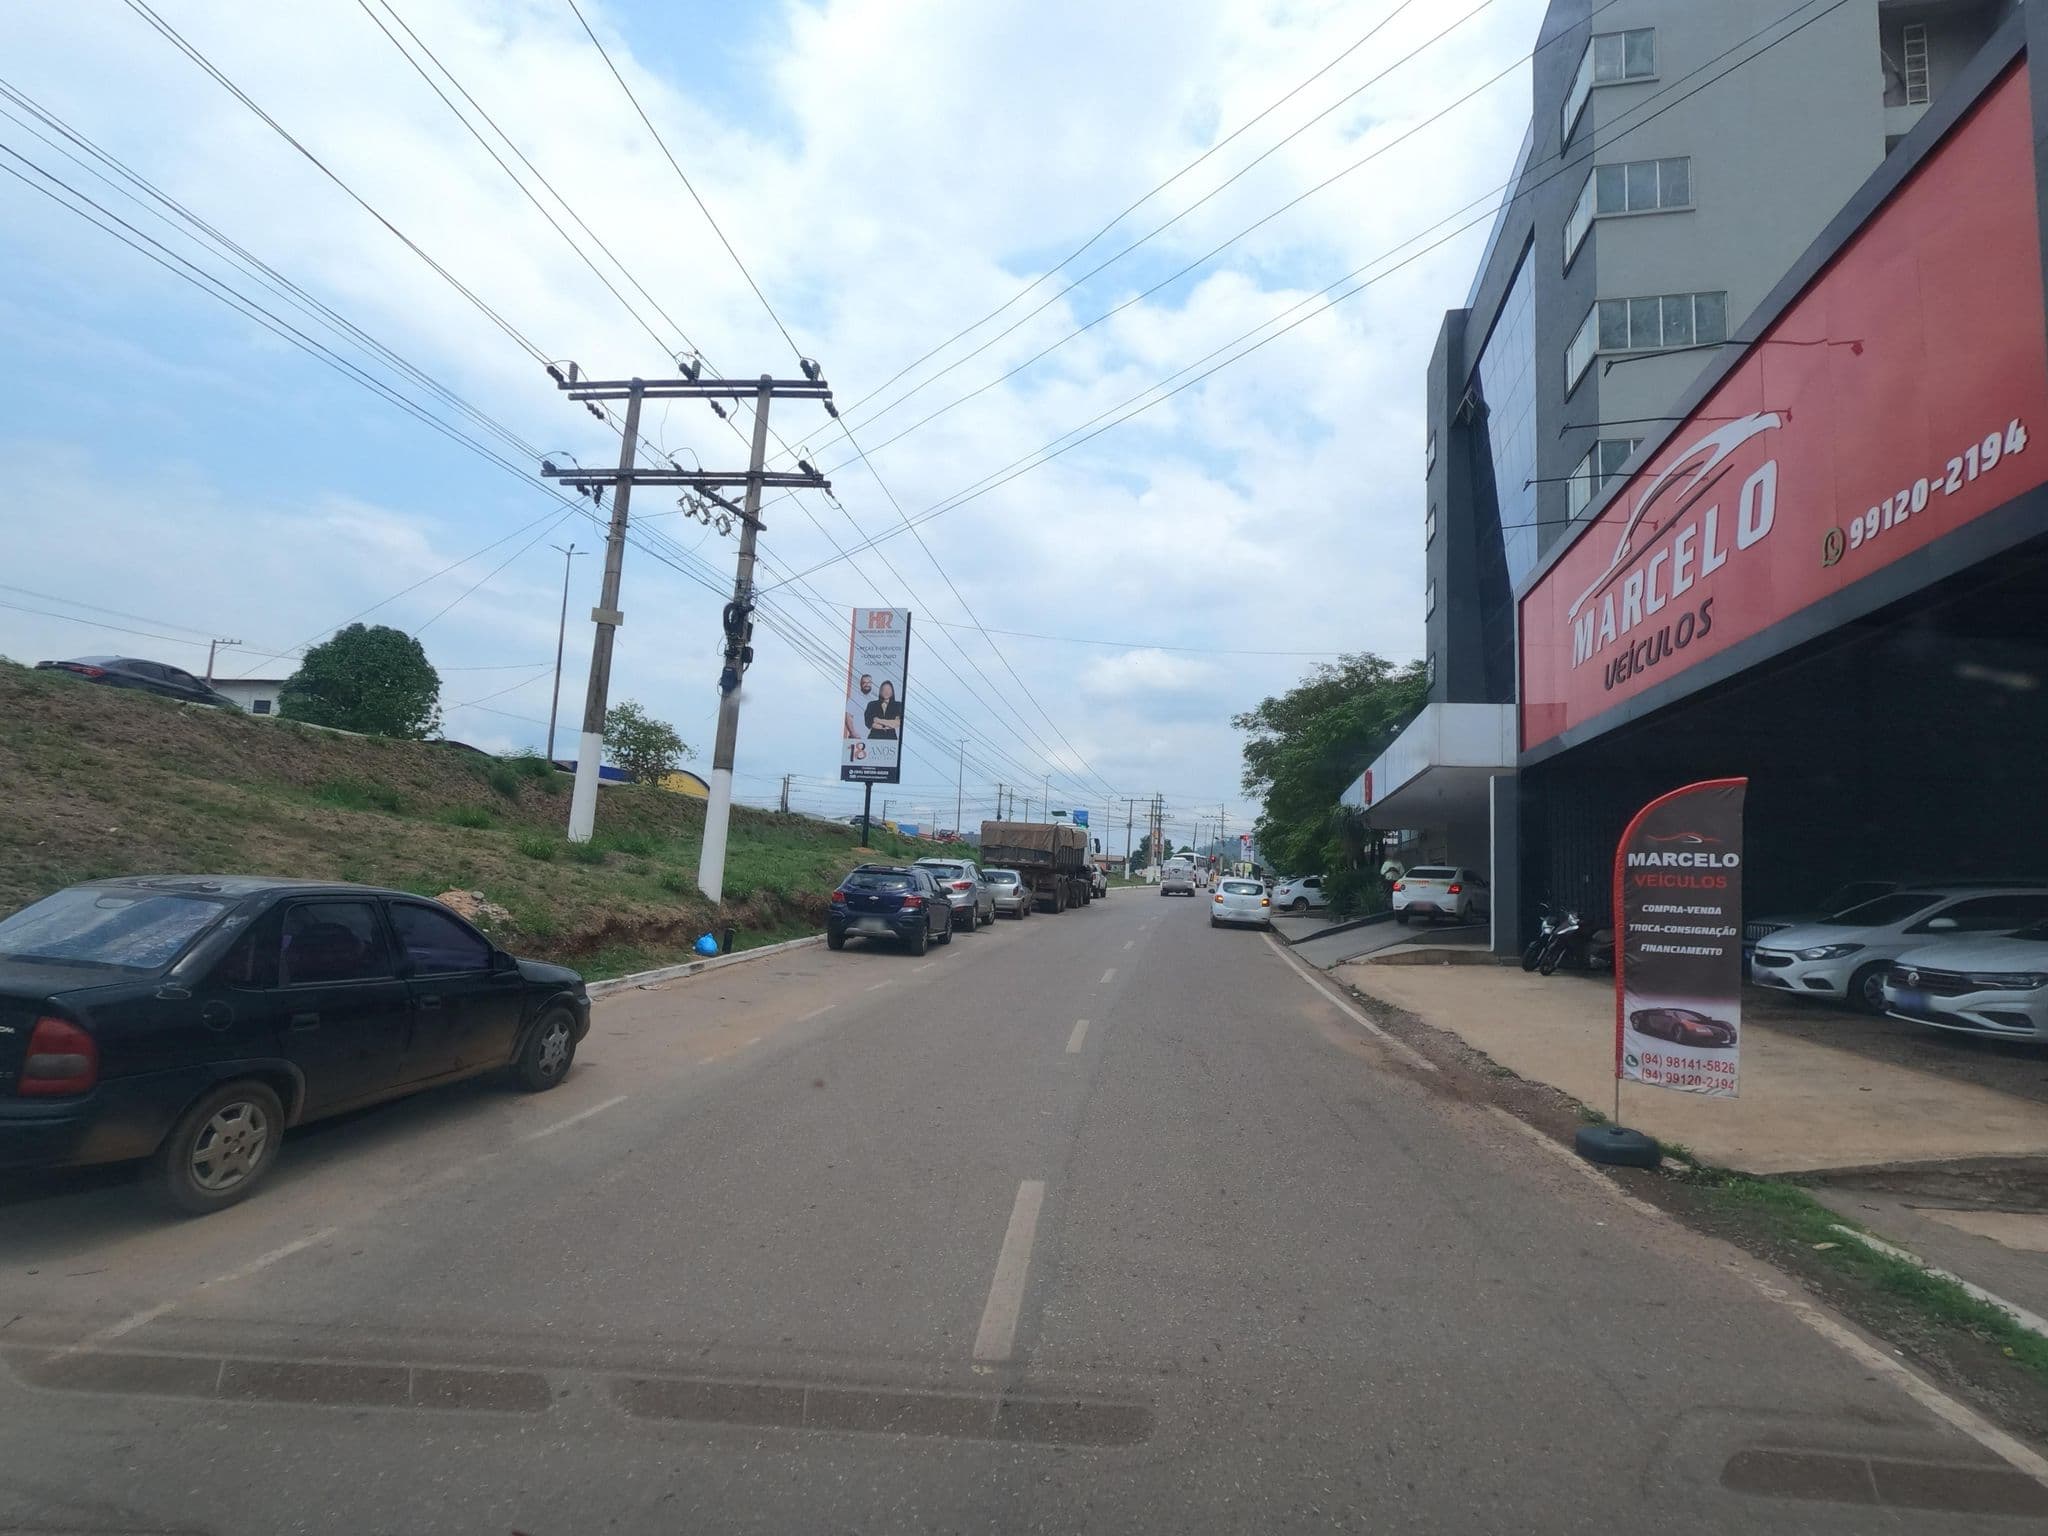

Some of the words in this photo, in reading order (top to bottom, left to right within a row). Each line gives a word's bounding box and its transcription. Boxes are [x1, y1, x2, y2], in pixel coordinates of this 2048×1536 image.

[1850, 418, 2028, 549] 99120-2194
[1571, 459, 1778, 669] MARCELO
[1604, 597, 1713, 690] VEÍCULOS
[1627, 852, 1740, 868] MARCELO
[1641, 904, 1722, 915] COMPRA-VENDA
[1629, 923, 1737, 937] TROCA-CONSIGNAÇÃO
[1640, 943, 1723, 956] FINANCIAMENTO
[1641, 1052, 1662, 1066] (94)
[1665, 1056, 1735, 1074] 98141-5826
[1641, 1068, 1662, 1084] (94)
[1665, 1073, 1734, 1090] 99120-2194
